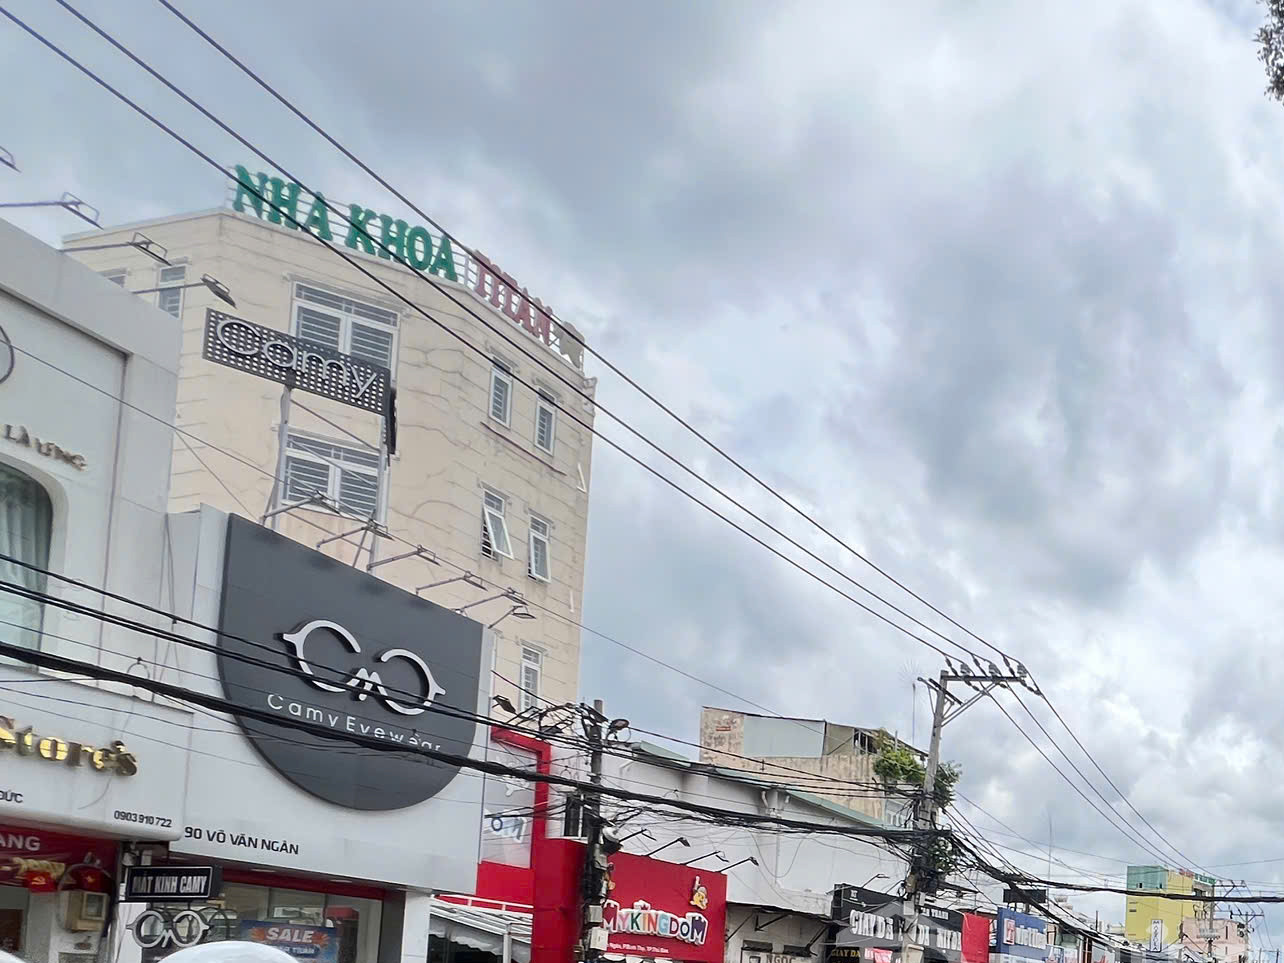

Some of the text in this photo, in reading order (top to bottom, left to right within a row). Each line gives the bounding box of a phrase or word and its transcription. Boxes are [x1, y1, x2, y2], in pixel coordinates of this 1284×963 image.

[345, 204, 459, 282] KHOA
[217, 320, 376, 398] Camy
[114, 810, 172, 828] 0903 910 722
[185, 826, 299, 855] 90 VÕ VĂN NGÂN
[180, 876, 208, 893] CAMY
[266, 927, 315, 943] SALE
[602, 899, 709, 945] MYKINGDOM
